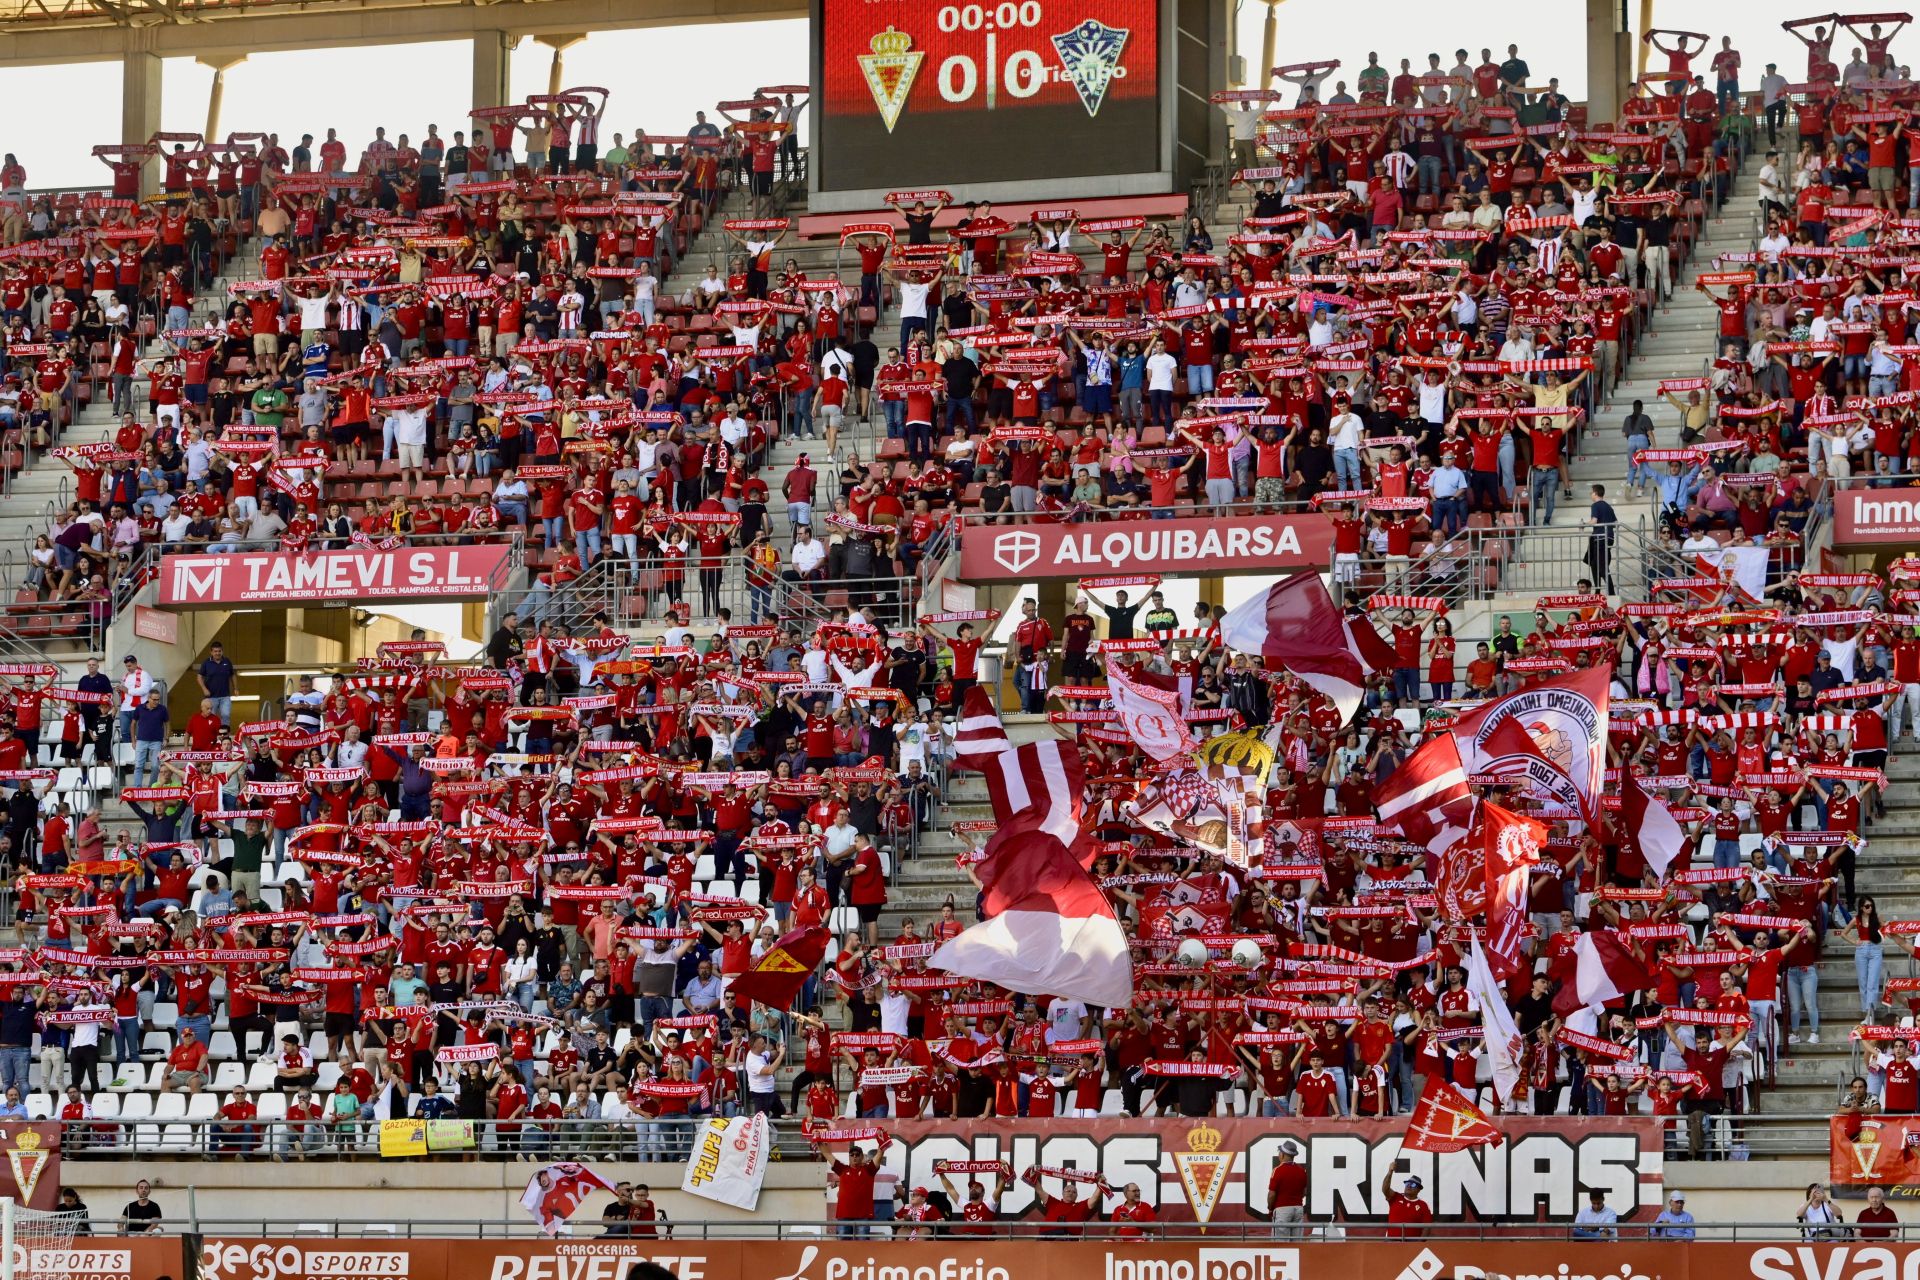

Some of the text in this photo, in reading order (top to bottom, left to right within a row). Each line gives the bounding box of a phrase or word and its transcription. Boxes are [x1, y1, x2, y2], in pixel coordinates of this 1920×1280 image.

[939, 1, 1042, 32] 00:00
[939, 50, 1044, 102] 0 0
[1366, 272, 1420, 282] REAL MURCIA
[1855, 496, 1920, 524] Inm
[1054, 526, 1301, 568] ALQUIBARSA
[244, 552, 482, 590] TAMEVI S.L.
[368, 583, 489, 596] TOLDOS, MAMPARAS, CRISTALERÍA
[457, 667, 500, 677] murcia
[308, 852, 361, 864] FURIAGRANA
[1685, 869, 1743, 882] COMO UNA SOLA ALMA
[461, 884, 522, 895] LOS COLORAOS
[706, 910, 721, 919] real
[1734, 914, 1790, 927] COMO UNA SOLA ALMA
[887, 947, 901, 957] REAL
[903, 945, 923, 956] MURCIA
[1676, 953, 1737, 964] COMO UNA SOLA ALMA
[1672, 1010, 1735, 1024] COMO UNA SOLA ALMA
[453, 1048, 498, 1059] COLORAOS
[1163, 1063, 1222, 1074] COMO UNA SOLA ALMA
[745, 1130, 760, 1176] PEÑA LOS
[951, 1162, 968, 1170] real
[556, 1244, 637, 1256] CARROCERIAS
[38, 1254, 124, 1268] SPORTS
[312, 1256, 401, 1271] SPORTS
[1106, 1252, 1194, 1280] Inmo
